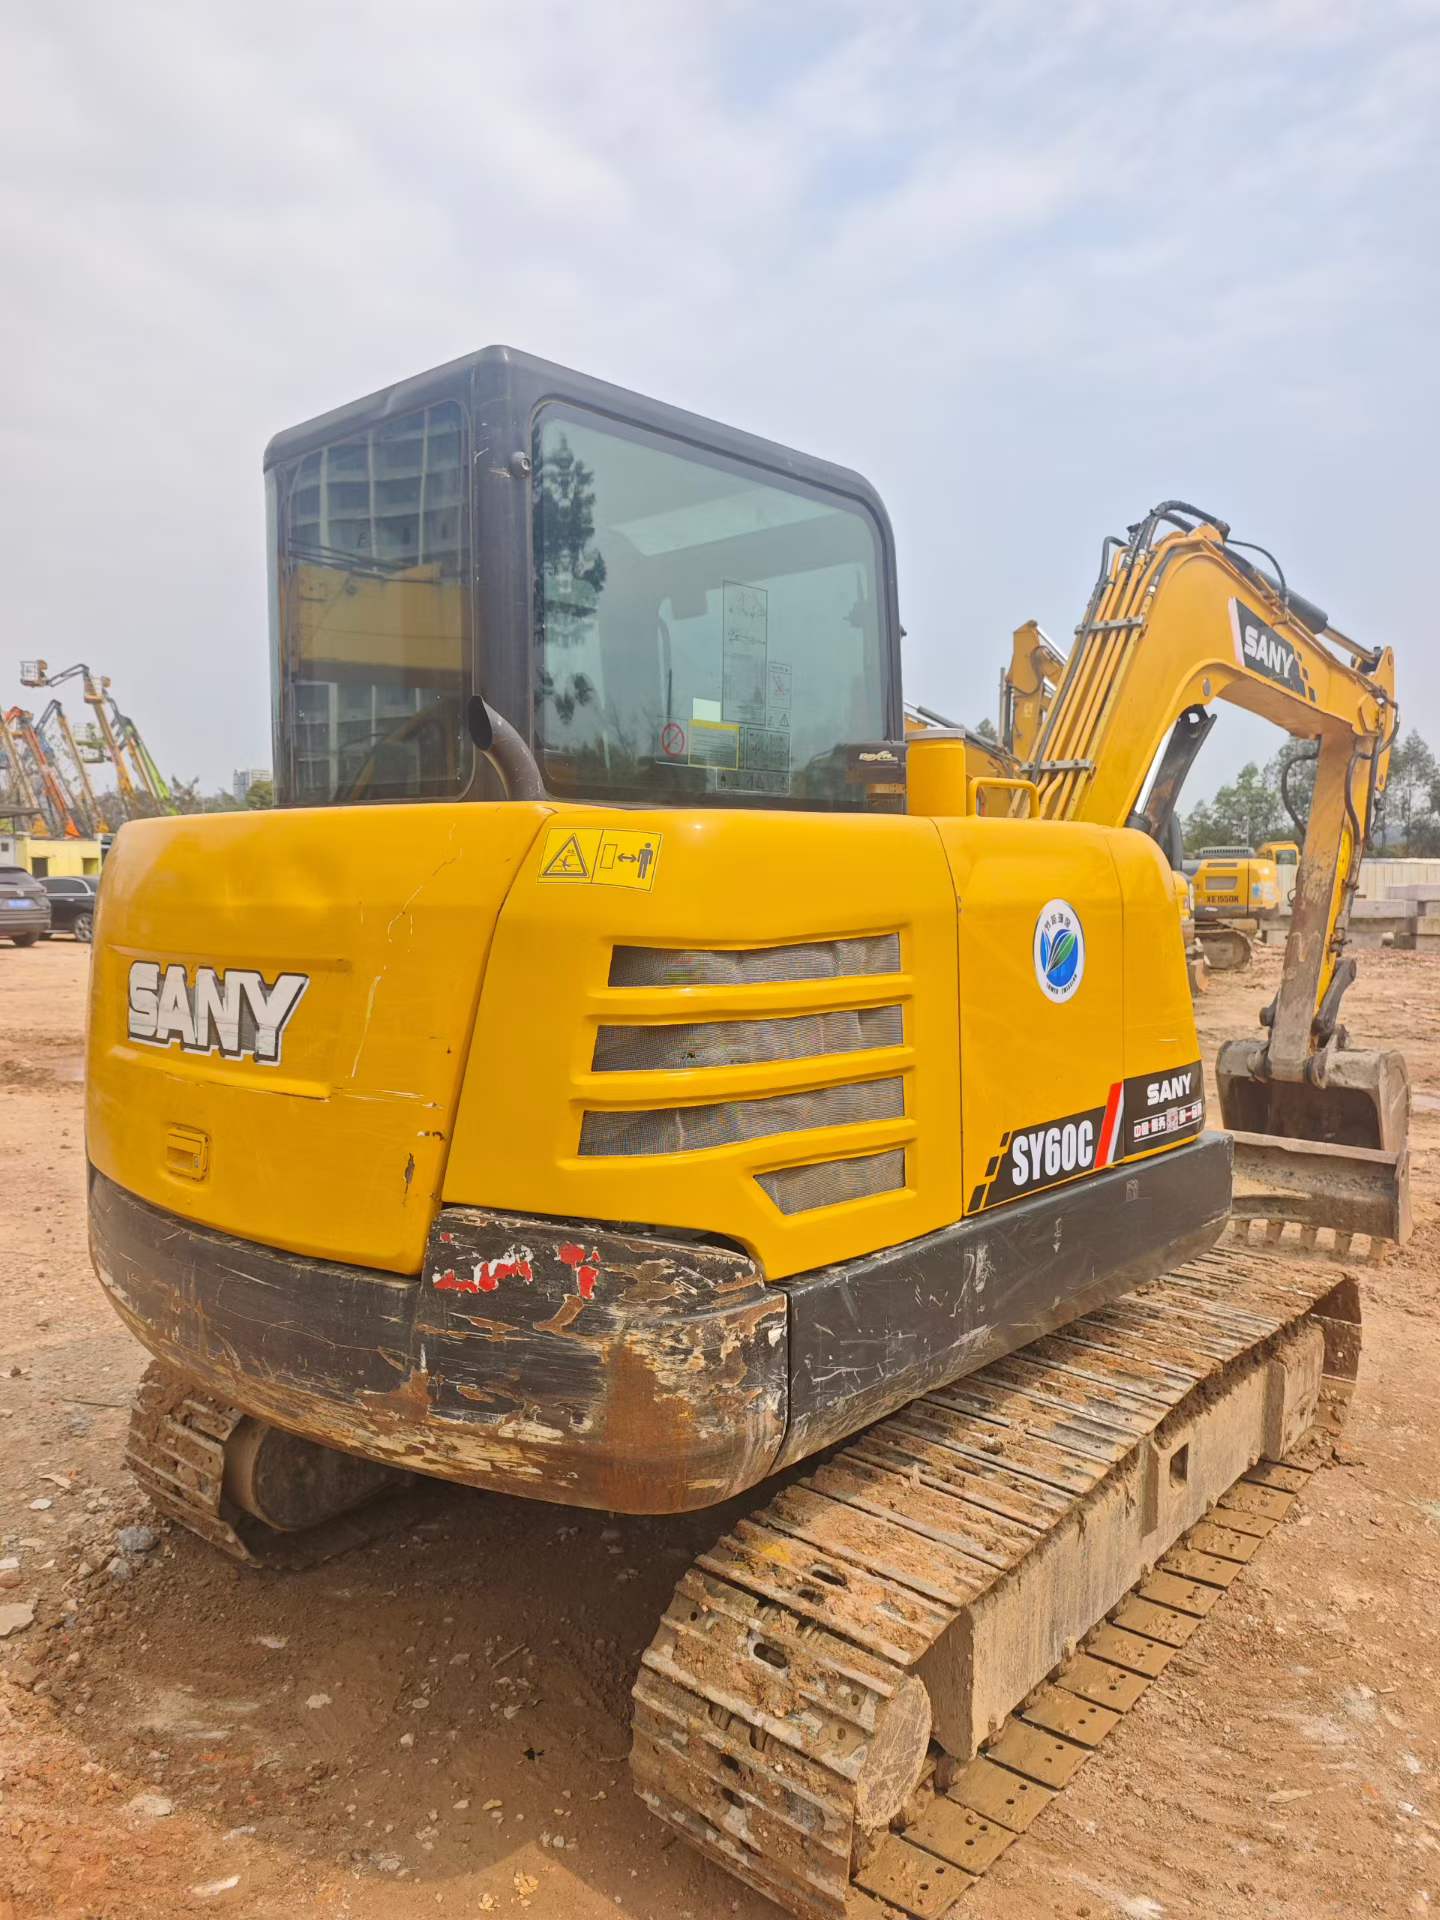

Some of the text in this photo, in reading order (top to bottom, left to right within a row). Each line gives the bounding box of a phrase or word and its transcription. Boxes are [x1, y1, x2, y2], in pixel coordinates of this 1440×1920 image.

[1243, 625, 1295, 678] SANY
[128, 960, 310, 1067] SANY
[1147, 1072, 1192, 1106] SANY
[1012, 1120, 1093, 1186] SY60C
